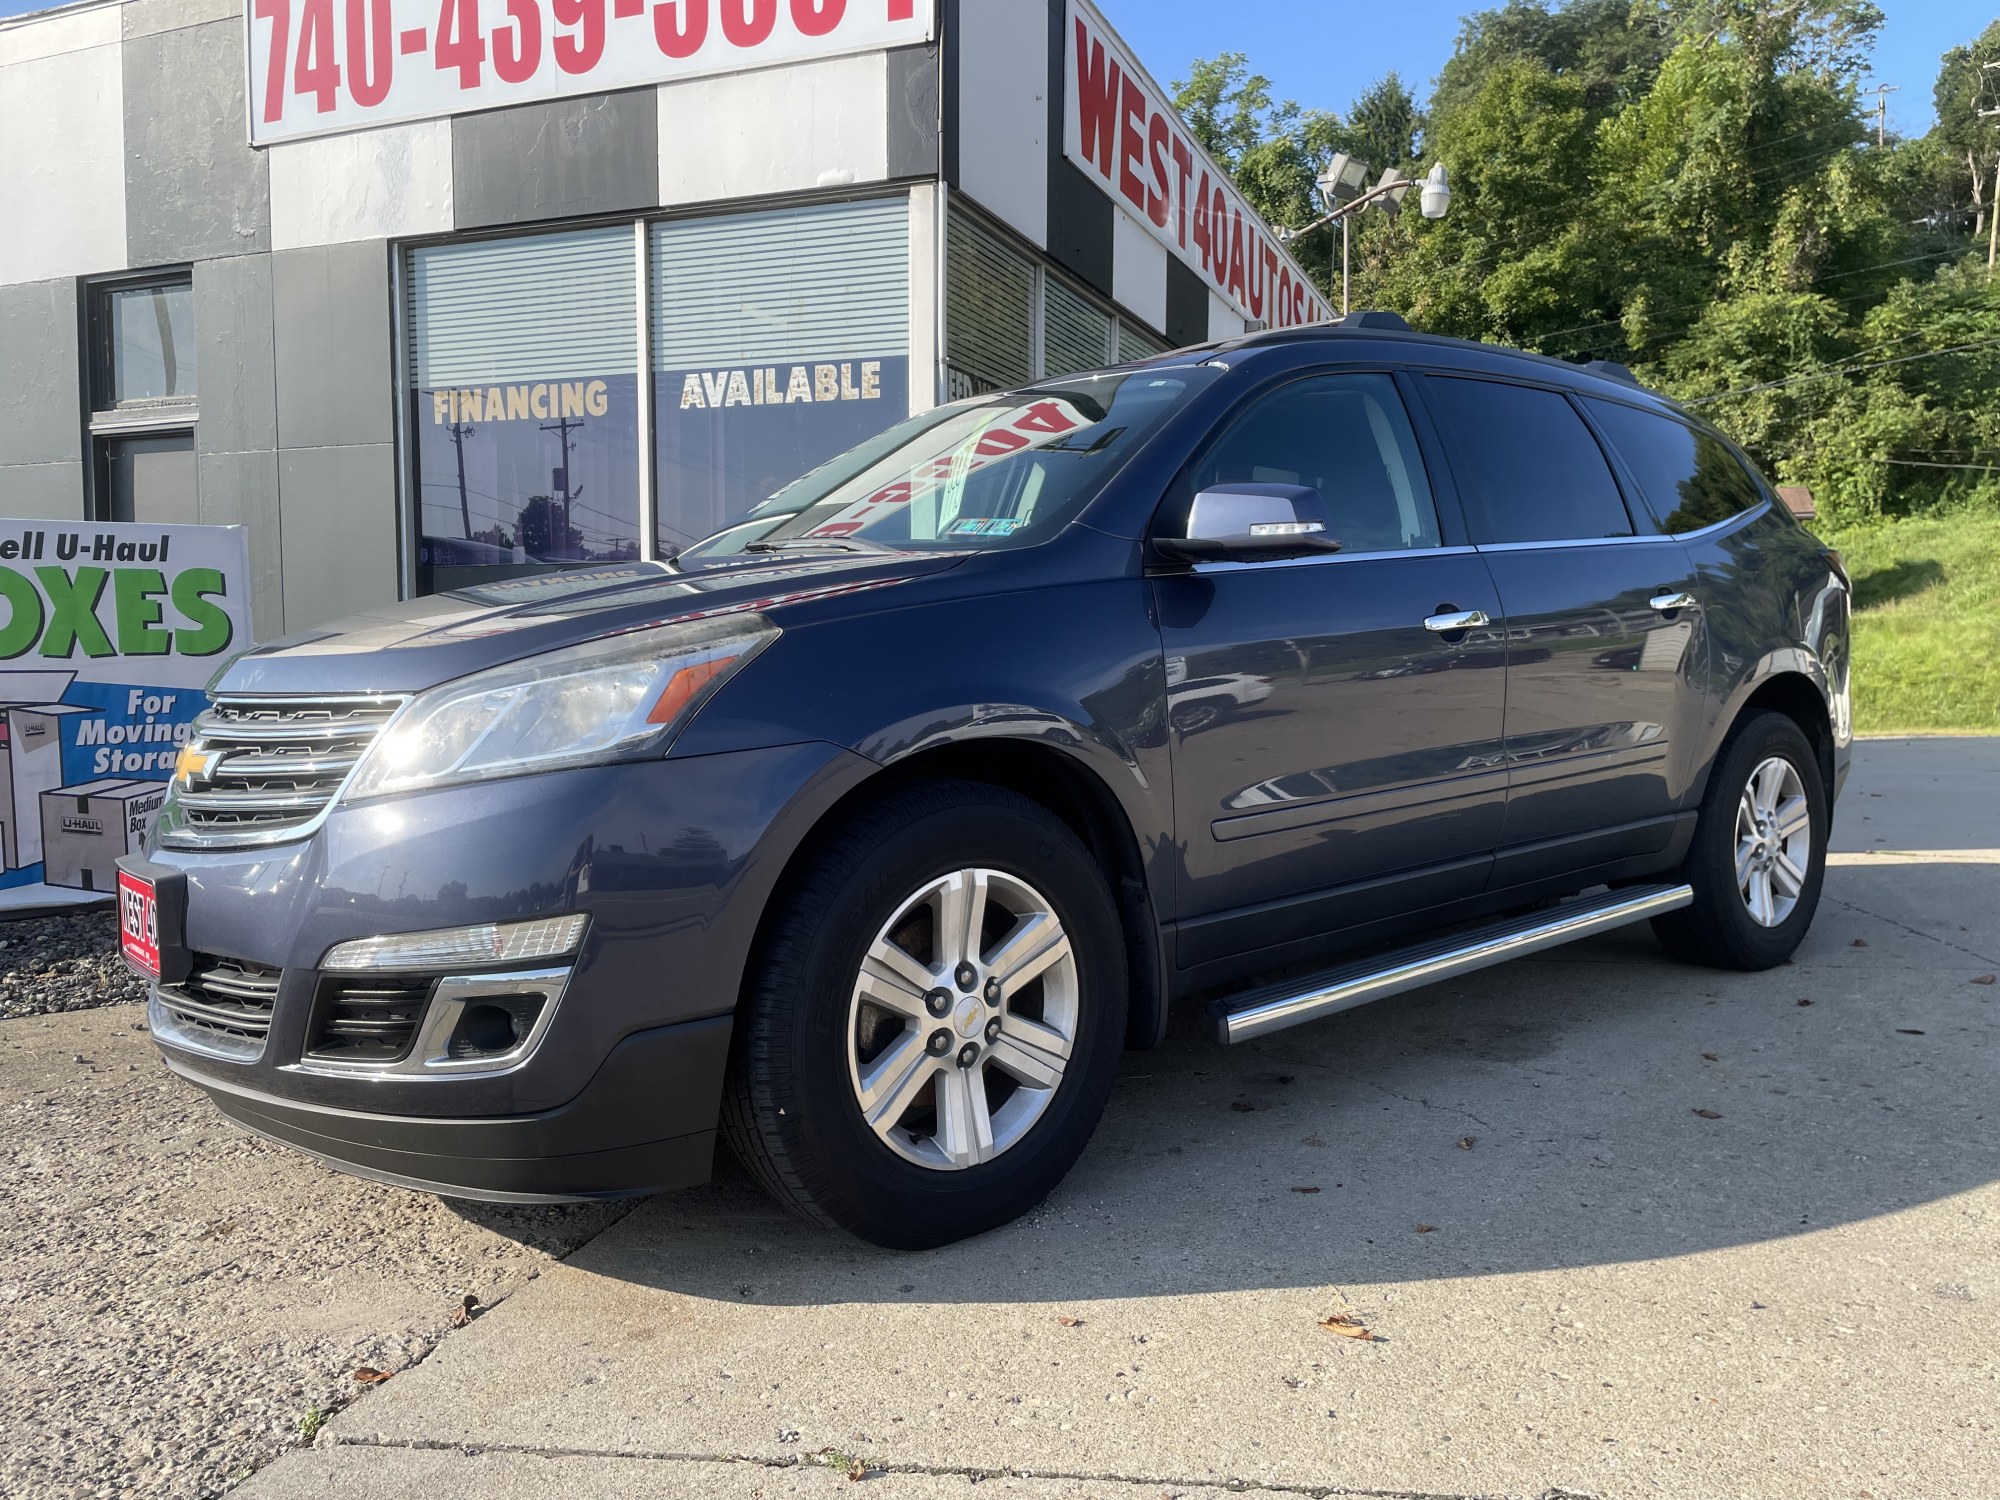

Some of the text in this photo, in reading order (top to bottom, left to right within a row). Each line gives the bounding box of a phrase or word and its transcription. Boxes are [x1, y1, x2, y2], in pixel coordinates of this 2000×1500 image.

[255, 0, 913, 123] 740-439-
[433, 361, 880, 424] FINANCING AVAILABLE
[56, 534, 169, 562] U-Haul
[127, 689, 176, 715] For
[25, 723, 45, 733] U-HAUL
[76, 716, 192, 748] Moving
[63, 819, 101, 830] U-HAUL
[130, 816, 147, 833] Box
[120, 884, 145, 942] WEST
